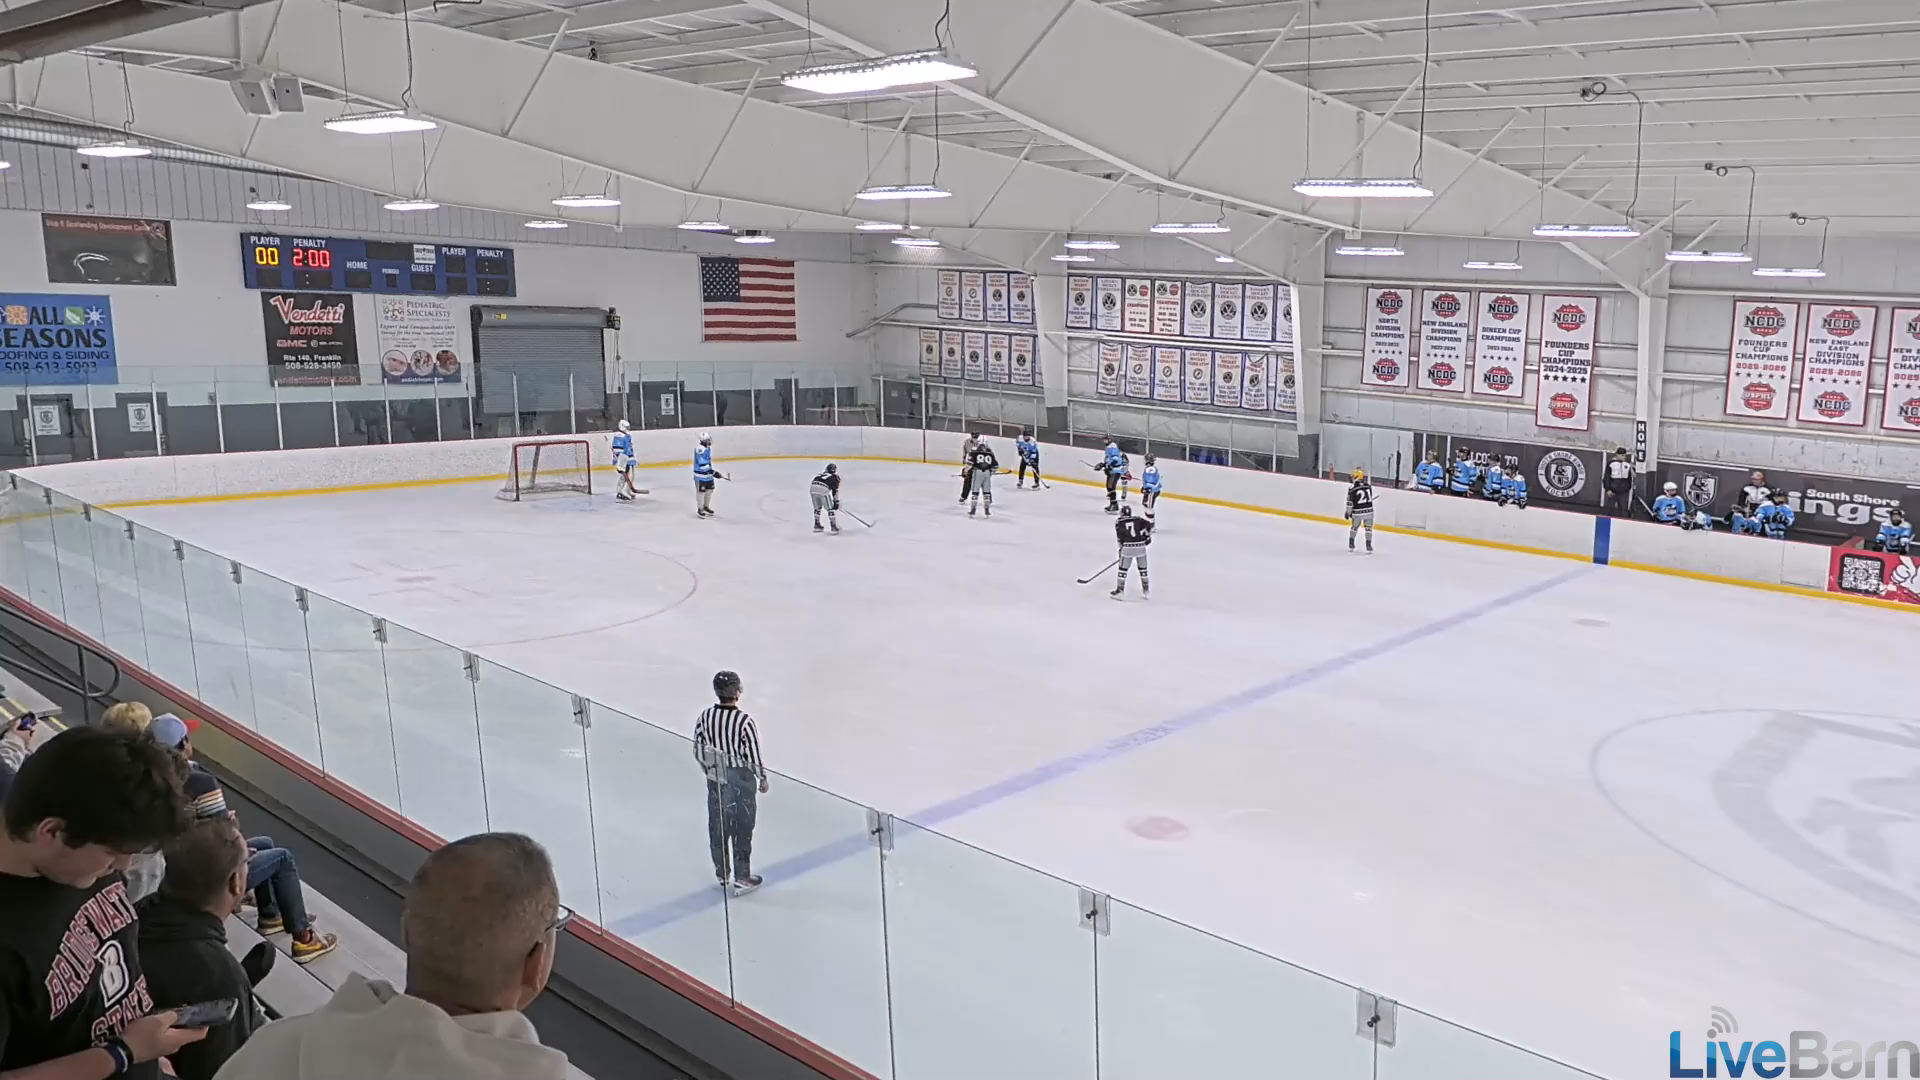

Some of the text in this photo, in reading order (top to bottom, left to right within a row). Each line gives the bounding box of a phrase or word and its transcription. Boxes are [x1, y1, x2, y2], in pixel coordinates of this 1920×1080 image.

[250, 235, 280, 245] PLAYER
[293, 238, 326, 248] PENALTY
[255, 247, 279, 265] 00
[442, 246, 466, 256] PLAYER
[477, 248, 504, 258] PENALTY
[293, 248, 330, 267] 2:00
[346, 261, 368, 270] HOME
[411, 264, 433, 273] GUEST
[406, 301, 445, 310] PEDIATRIC
[1376, 298, 1403, 308] NCDC
[1431, 301, 1461, 311] NCDC
[269, 295, 345, 324] Vendetti
[406, 309, 451, 318] SPECIALISTS
[1488, 304, 1519, 314] NCDC
[30, 306, 64, 326] ALL
[1553, 313, 1586, 323] NCDC
[1744, 315, 1786, 328] NCDC
[1822, 318, 1861, 330] NCDC
[289, 326, 334, 336] MOTORS
[1482, 326, 1522, 335] DINEEN CUP
[0, 328, 107, 349] EASONS
[1371, 332, 1405, 340] CHAMPIONS
[1425, 335, 1462, 343] CHAMPIONS
[1481, 334, 1520, 343] CHAMPIONS
[1544, 341, 1590, 350] FOUNDERS
[1738, 339, 1788, 348] FOUNDERS
[1831, 339, 1869, 347] ENGLAND
[52, 351, 62, 360] &
[65, 351, 110, 360] SIDING
[1735, 352, 1789, 362] CHAMPIONS
[1816, 351, 1859, 360] DIVISION
[1541, 356, 1591, 367] CHAMPIONS
[1808, 357, 1865, 367] CHAMPIONS
[1372, 365, 1400, 375] NCDC
[1427, 369, 1456, 380] NCDC
[1543, 365, 1588, 375] 2024-2025
[1483, 373, 1514, 385] NCDC
[1814, 399, 1850, 411] NCDC
[1899, 405, 1920, 417] NC
[1637, 423, 1646, 460] HOME
[1356, 489, 1372, 504] 21
[1806, 488, 1900, 506] South Shore
[1788, 491, 1906, 525] ings
[1125, 521, 1136, 537] 7
[45, 881, 138, 1020] BRIDGEWAT
[98, 940, 129, 1008] B
